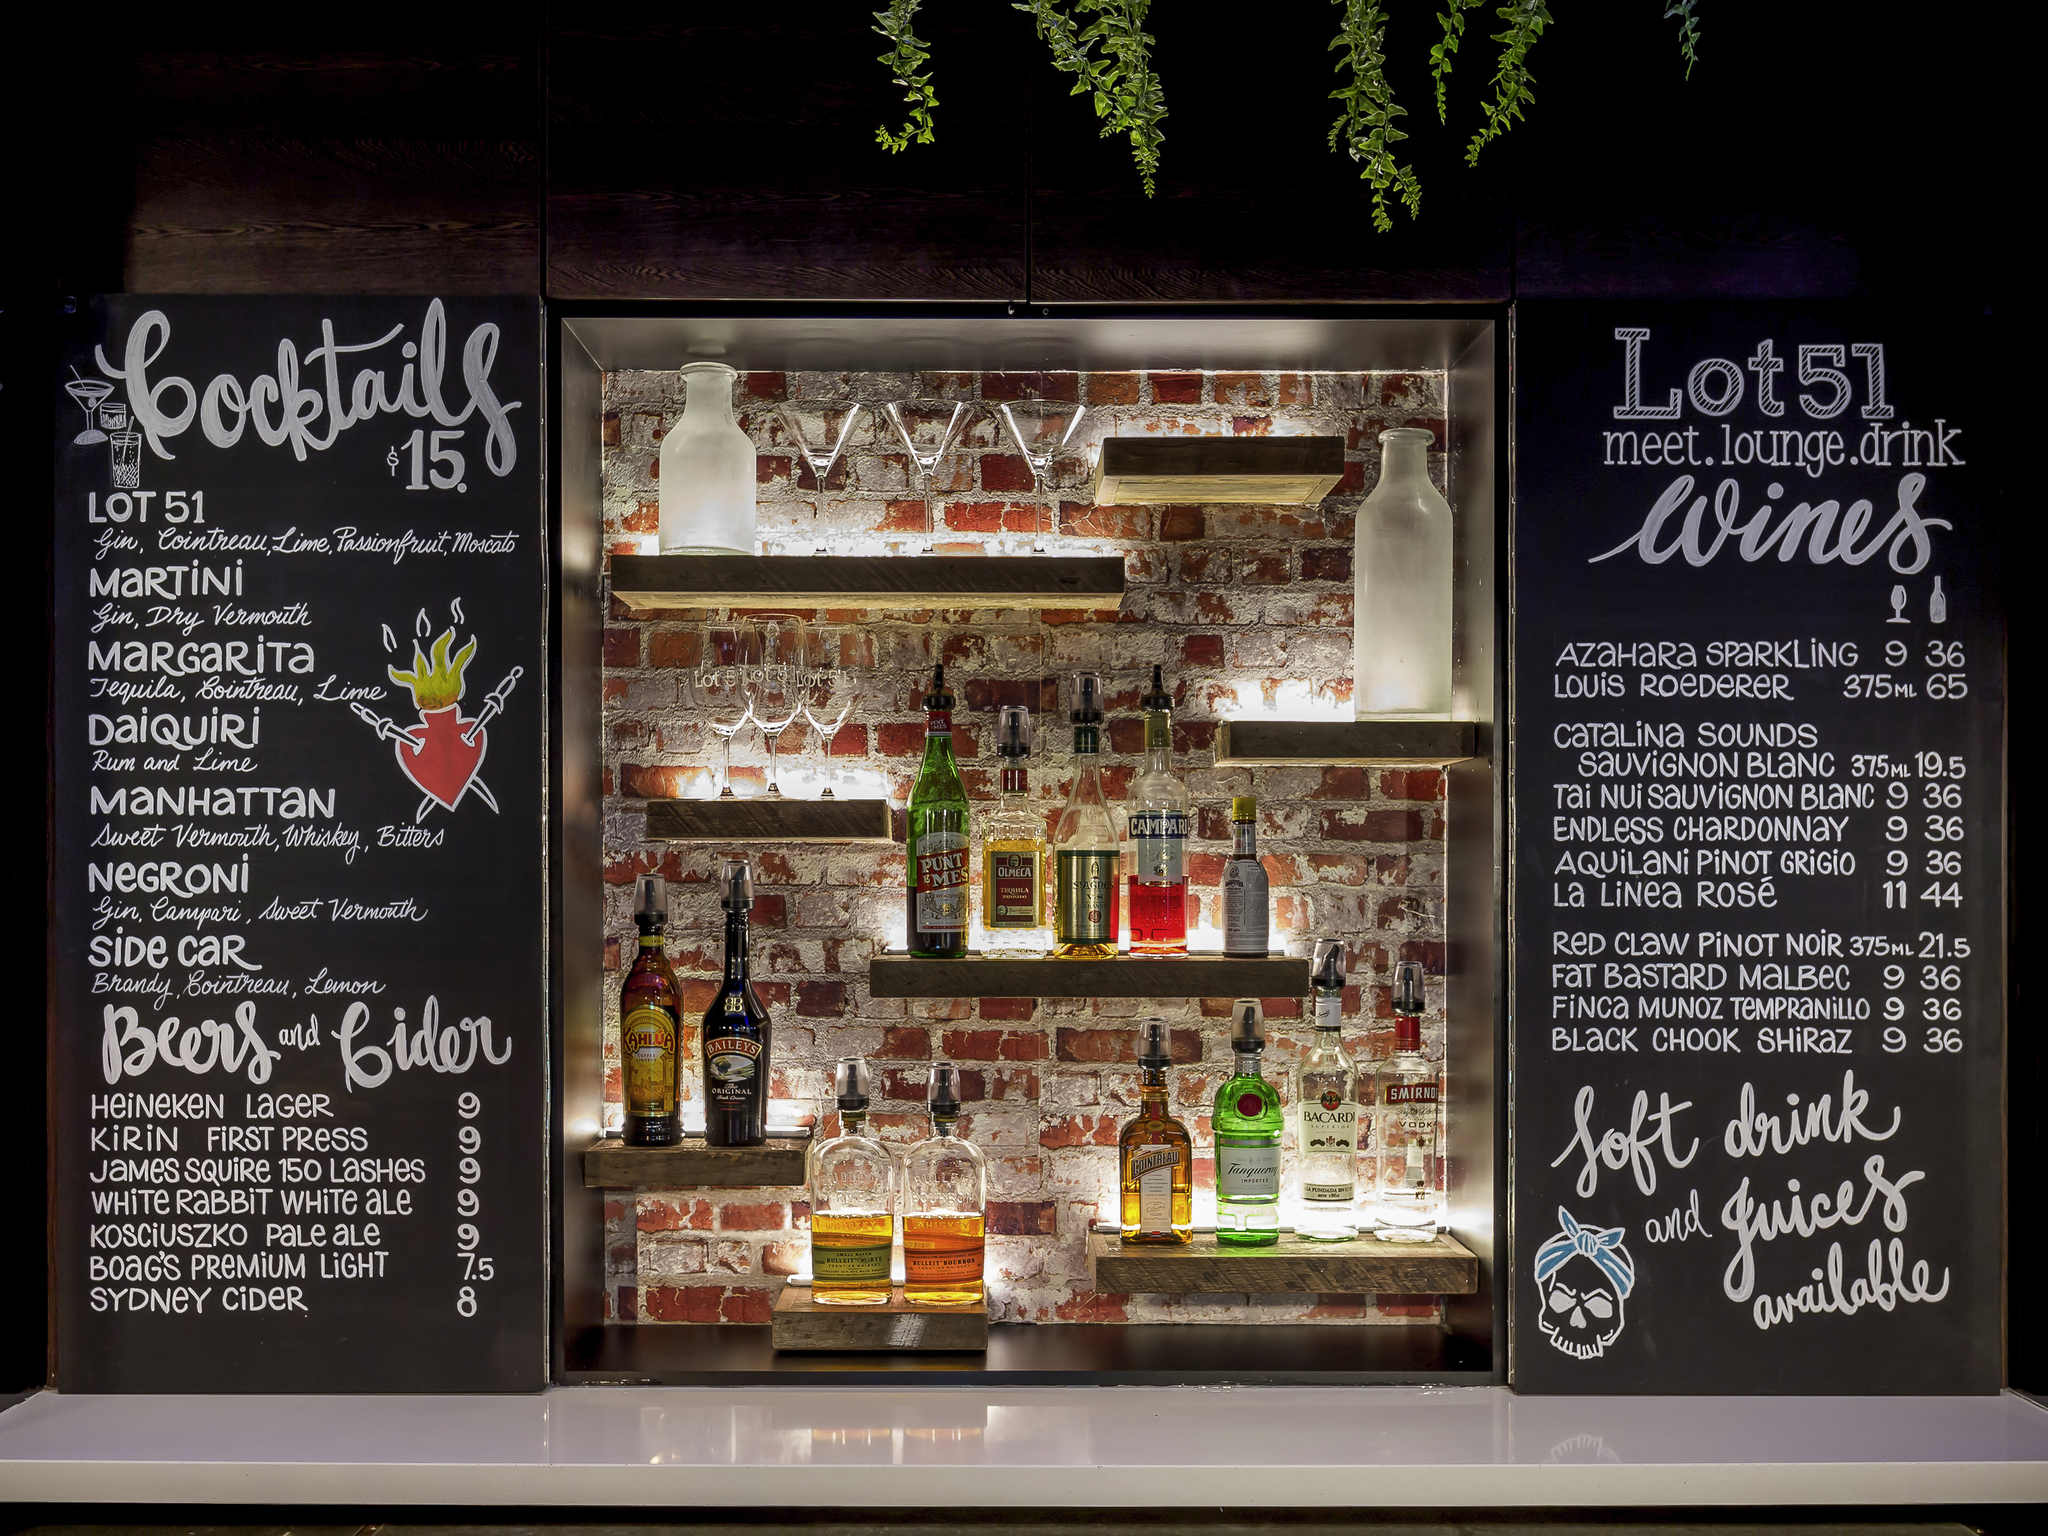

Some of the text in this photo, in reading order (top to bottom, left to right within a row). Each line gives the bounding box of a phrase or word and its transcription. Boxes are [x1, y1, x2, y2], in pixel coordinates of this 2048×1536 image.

[1614, 328, 1894, 419] Lot 51
[95, 298, 521, 477] Cocktails
[89, 491, 205, 523] LOT 51
[1588, 473, 1952, 574] Wines
[452, 531, 519, 553] Moscato
[145, 606, 204, 636] Dry
[213, 603, 312, 626] Vermouth
[1885, 640, 1907, 667] 9
[1925, 640, 1965, 667] 36
[313, 674, 387, 701] Lime
[1927, 673, 1968, 699] 65
[1698, 722, 1818, 748] SOUNDS
[92, 747, 258, 772] Rum and Lime
[1915, 751, 1966, 779] 19.5
[1886, 781, 1908, 809] 9
[1923, 783, 1962, 808] 36
[91, 823, 167, 847] Sweet
[377, 825, 444, 848] Bitters
[1131, 817, 1188, 836] CAMPARI
[1885, 816, 1907, 842] 9
[1925, 815, 1964, 841] 36
[921, 853, 963, 873] PUNT
[998, 867, 1032, 878] OLMECA
[1886, 850, 1908, 876] 9
[1926, 850, 1961, 875] 36
[933, 866, 969, 888] MES
[1883, 880, 1906, 909] 11
[1920, 881, 1963, 908] 44
[258, 896, 324, 920] Sweet
[328, 898, 428, 921] Vermouth
[1918, 931, 1971, 959] 21.5
[304, 967, 386, 994] Lemon
[1883, 965, 1905, 989] 9
[1920, 965, 1961, 991] 36
[1639, 996, 1723, 1019] MUNOZ
[1883, 997, 1904, 1021] 9
[1922, 998, 1962, 1020] 36
[102, 995, 512, 1093] Beers and Cider
[707, 1039, 759, 1055] BAILEYS
[1653, 1027, 1741, 1053] CHOOK
[1882, 1027, 1906, 1053] 9
[1923, 1027, 1963, 1053] 36
[711, 1087, 752, 1096] ORIGINAL
[1390, 1086, 1437, 1100] SMIRNO
[458, 1092, 480, 1119] 9
[1303, 1111, 1356, 1123] BACARDI
[459, 1126, 481, 1154] 9
[1551, 1069, 1901, 1198] Soft drink
[278, 1158, 322, 1183] 150
[459, 1158, 481, 1184] 9
[1133, 1151, 1179, 1176] COINTREAU
[457, 1189, 479, 1216] 9
[457, 1224, 479, 1250] 9
[1645, 1155, 1925, 1302] and Juices
[457, 1253, 494, 1280] 7.5
[1753, 1238, 1949, 1330] available
[457, 1286, 477, 1317] 8
